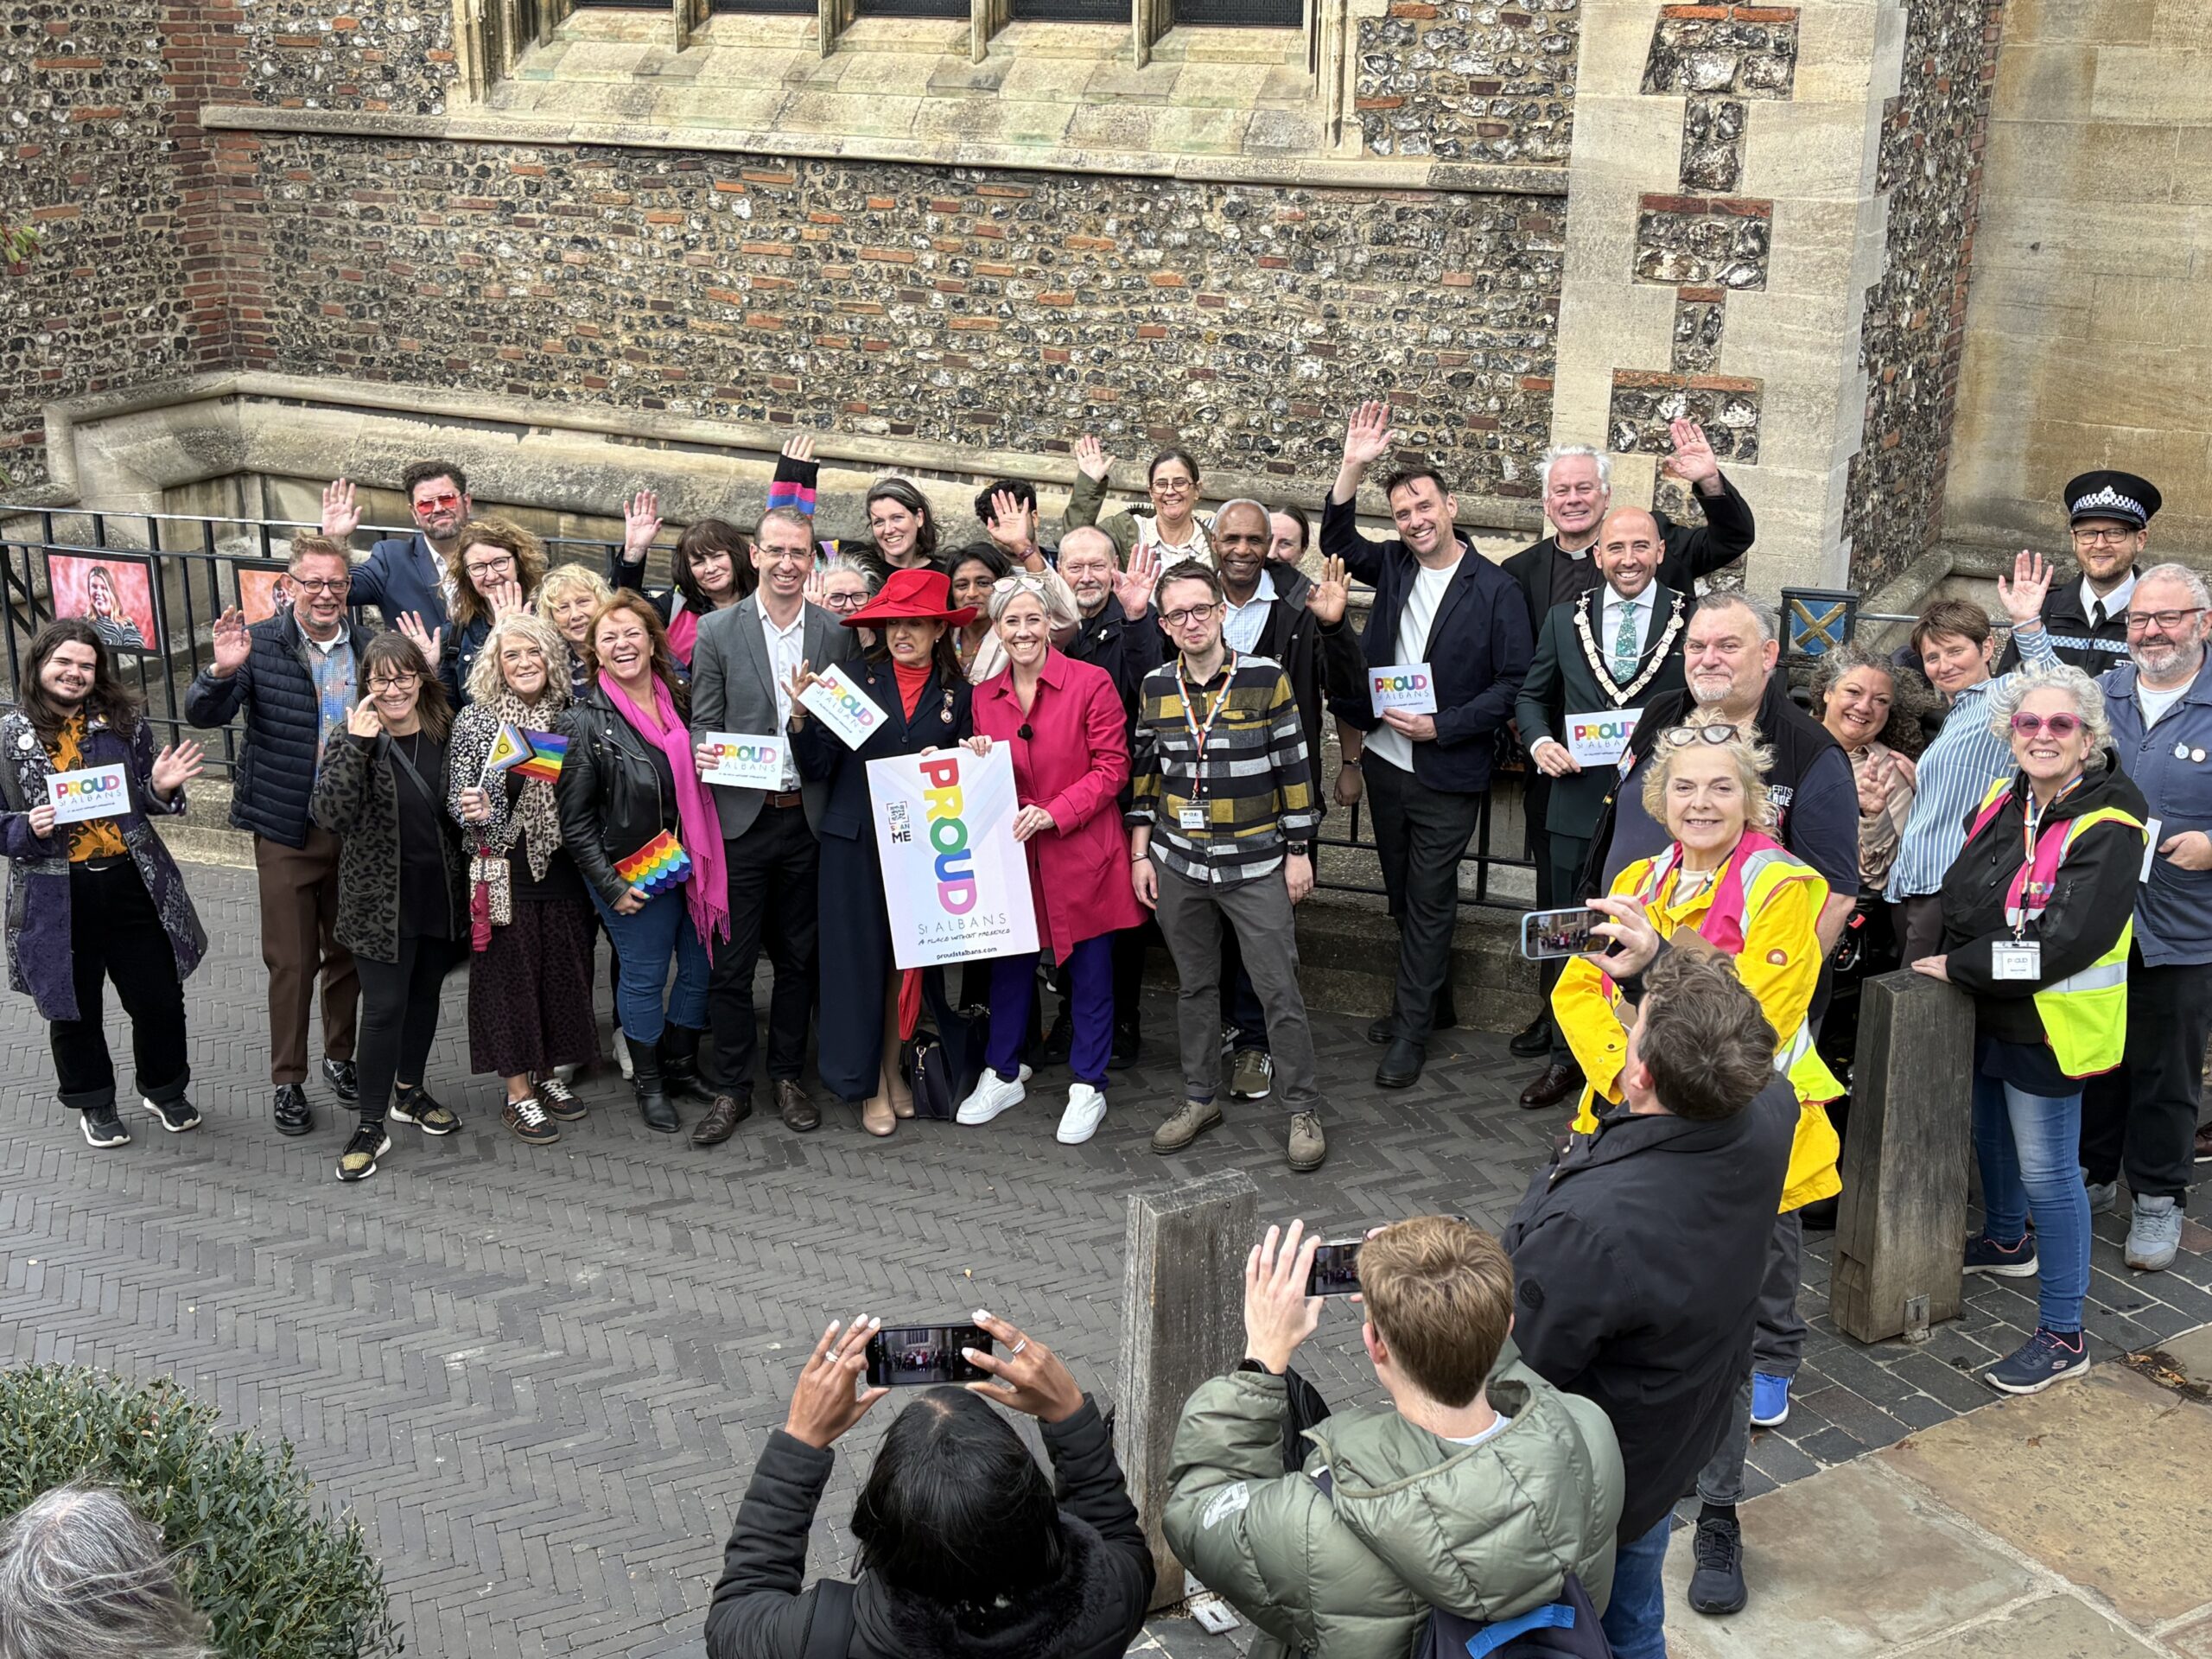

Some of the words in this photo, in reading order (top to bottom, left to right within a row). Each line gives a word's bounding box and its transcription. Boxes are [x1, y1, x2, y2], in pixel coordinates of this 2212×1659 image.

[1375, 674, 1427, 693] PROUD
[713, 744, 777, 764] PROUD
[724, 761, 776, 772] ALBANS
[55, 774, 120, 799] PROUD
[71, 790, 123, 804] ALBANS
[892, 831, 912, 844] ME
[919, 758, 977, 915] PROUD
[936, 913, 1007, 932] ALBANS
[937, 947, 998, 960] proudstalbans.com
